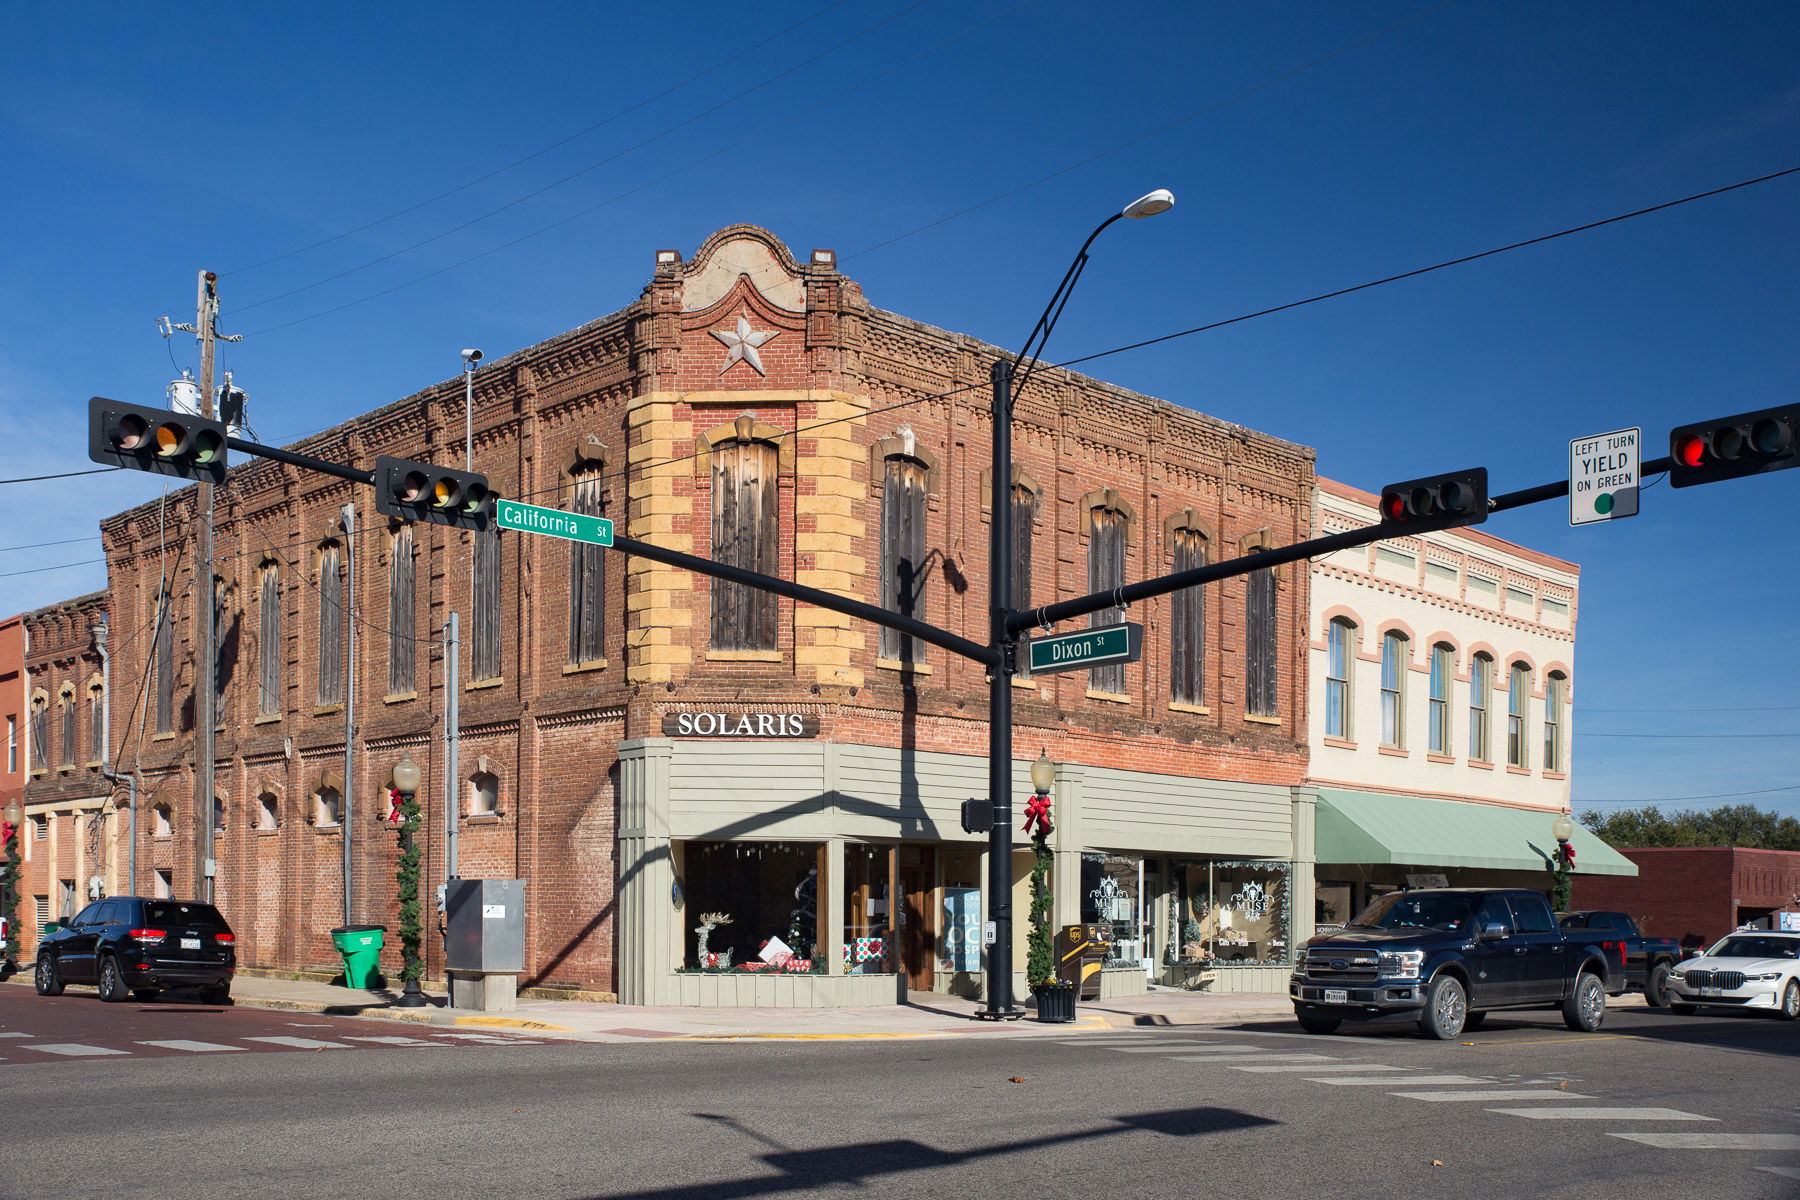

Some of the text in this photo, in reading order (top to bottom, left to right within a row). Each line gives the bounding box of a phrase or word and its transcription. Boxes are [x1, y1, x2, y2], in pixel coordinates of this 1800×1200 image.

[1575, 434, 1634, 456] LEFT TURN
[1582, 452, 1627, 475] YIELD
[1577, 472, 1632, 492] ON GREEN
[504, 506, 607, 538] California St
[1052, 636, 1105, 661] Dixon St
[678, 713, 804, 736] SOLARIS
[1236, 901, 1269, 911] MUSE
